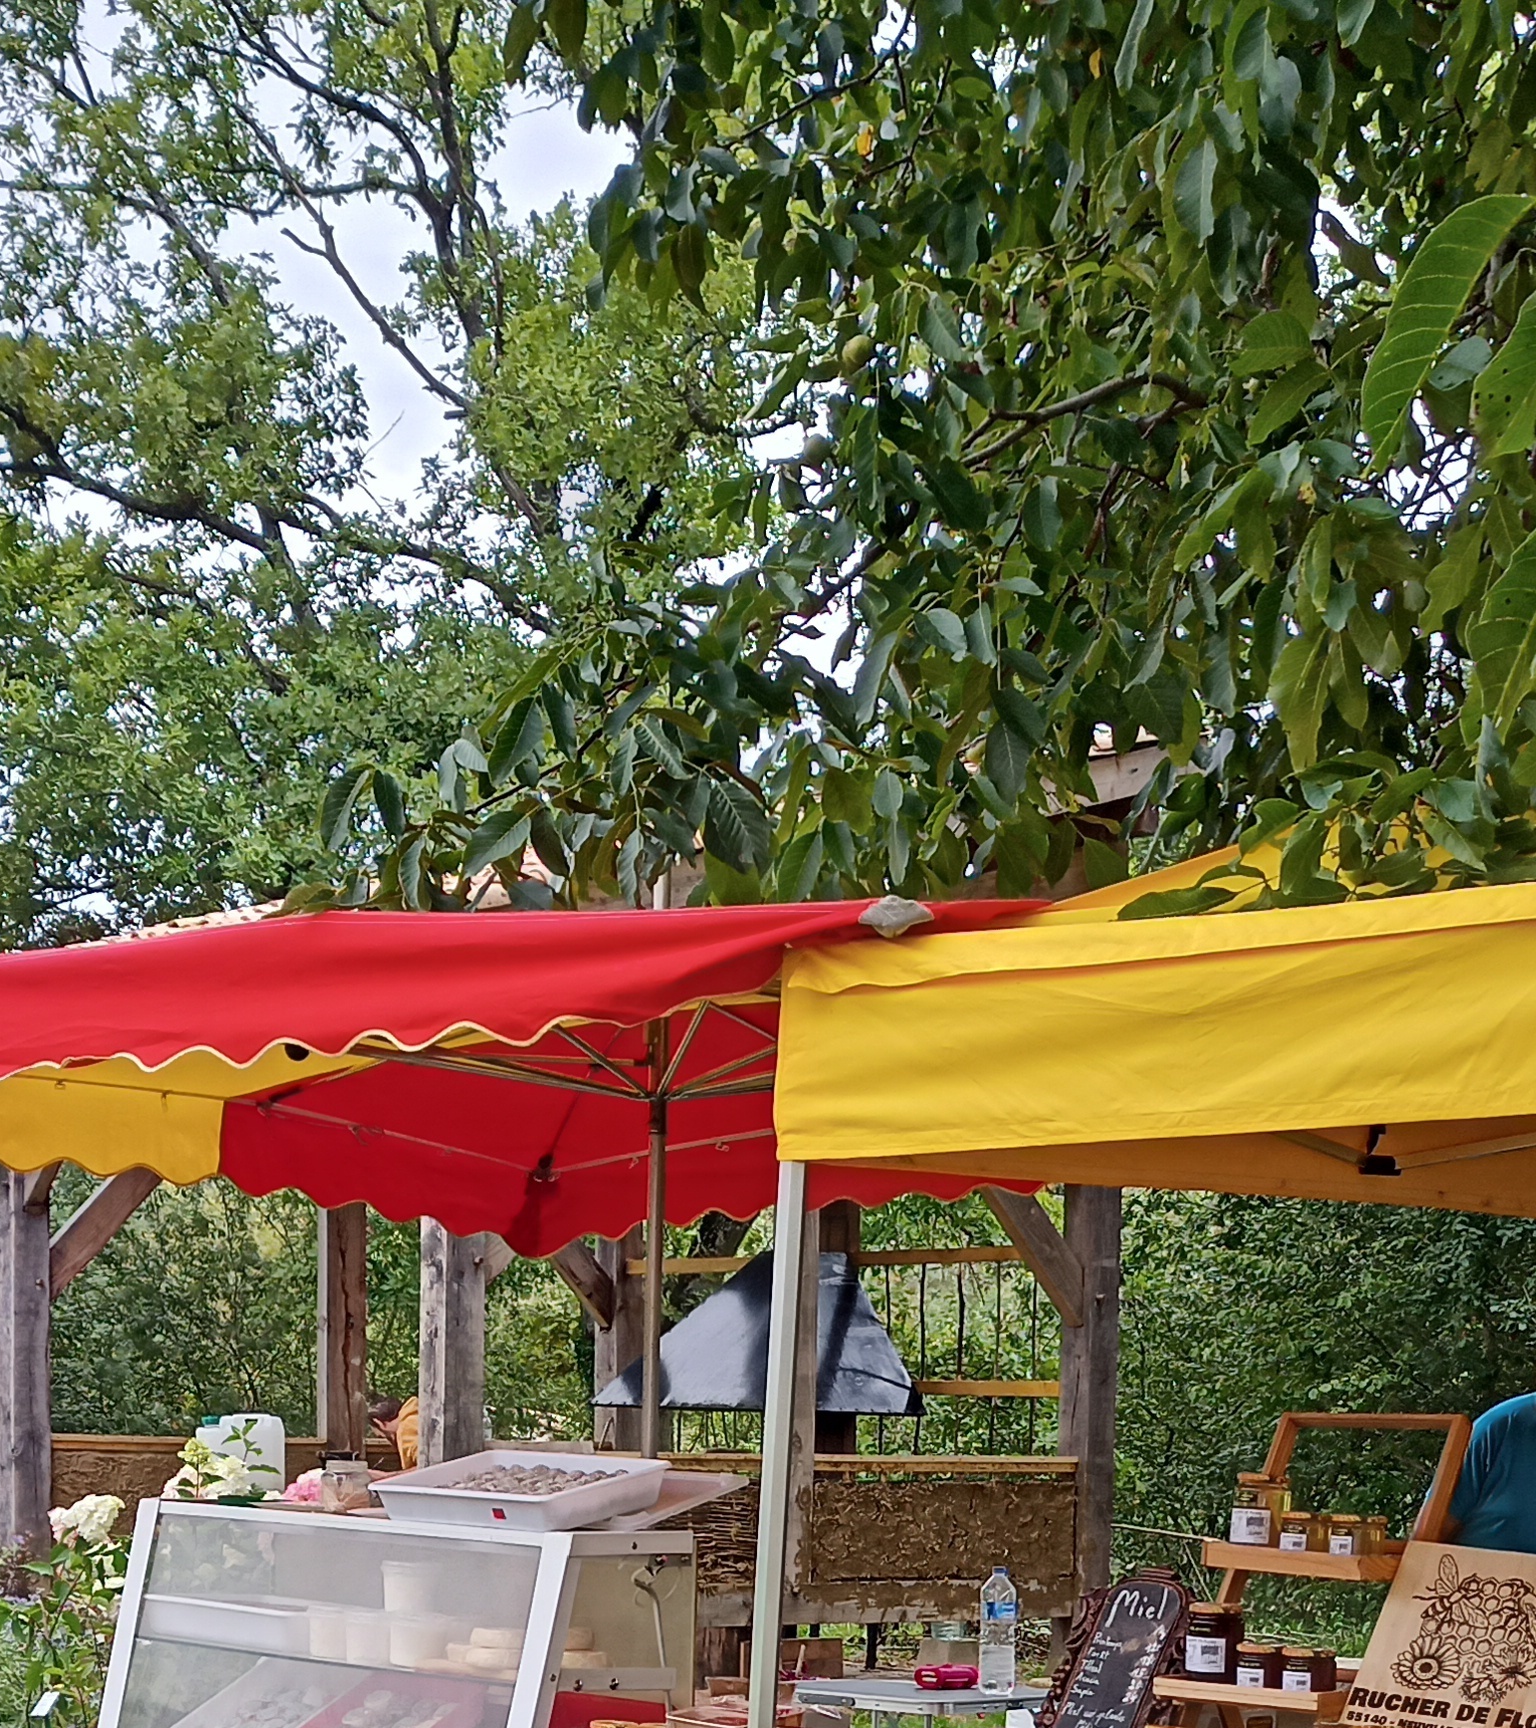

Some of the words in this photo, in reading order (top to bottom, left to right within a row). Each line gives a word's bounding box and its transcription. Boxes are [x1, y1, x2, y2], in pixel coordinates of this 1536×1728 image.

[1104, 1586, 1168, 1627] Miel
[1346, 1710, 1387, 1726] 55140
[1348, 1687, 1453, 1719] RUCHER
[1455, 1703, 1493, 1724] DE
